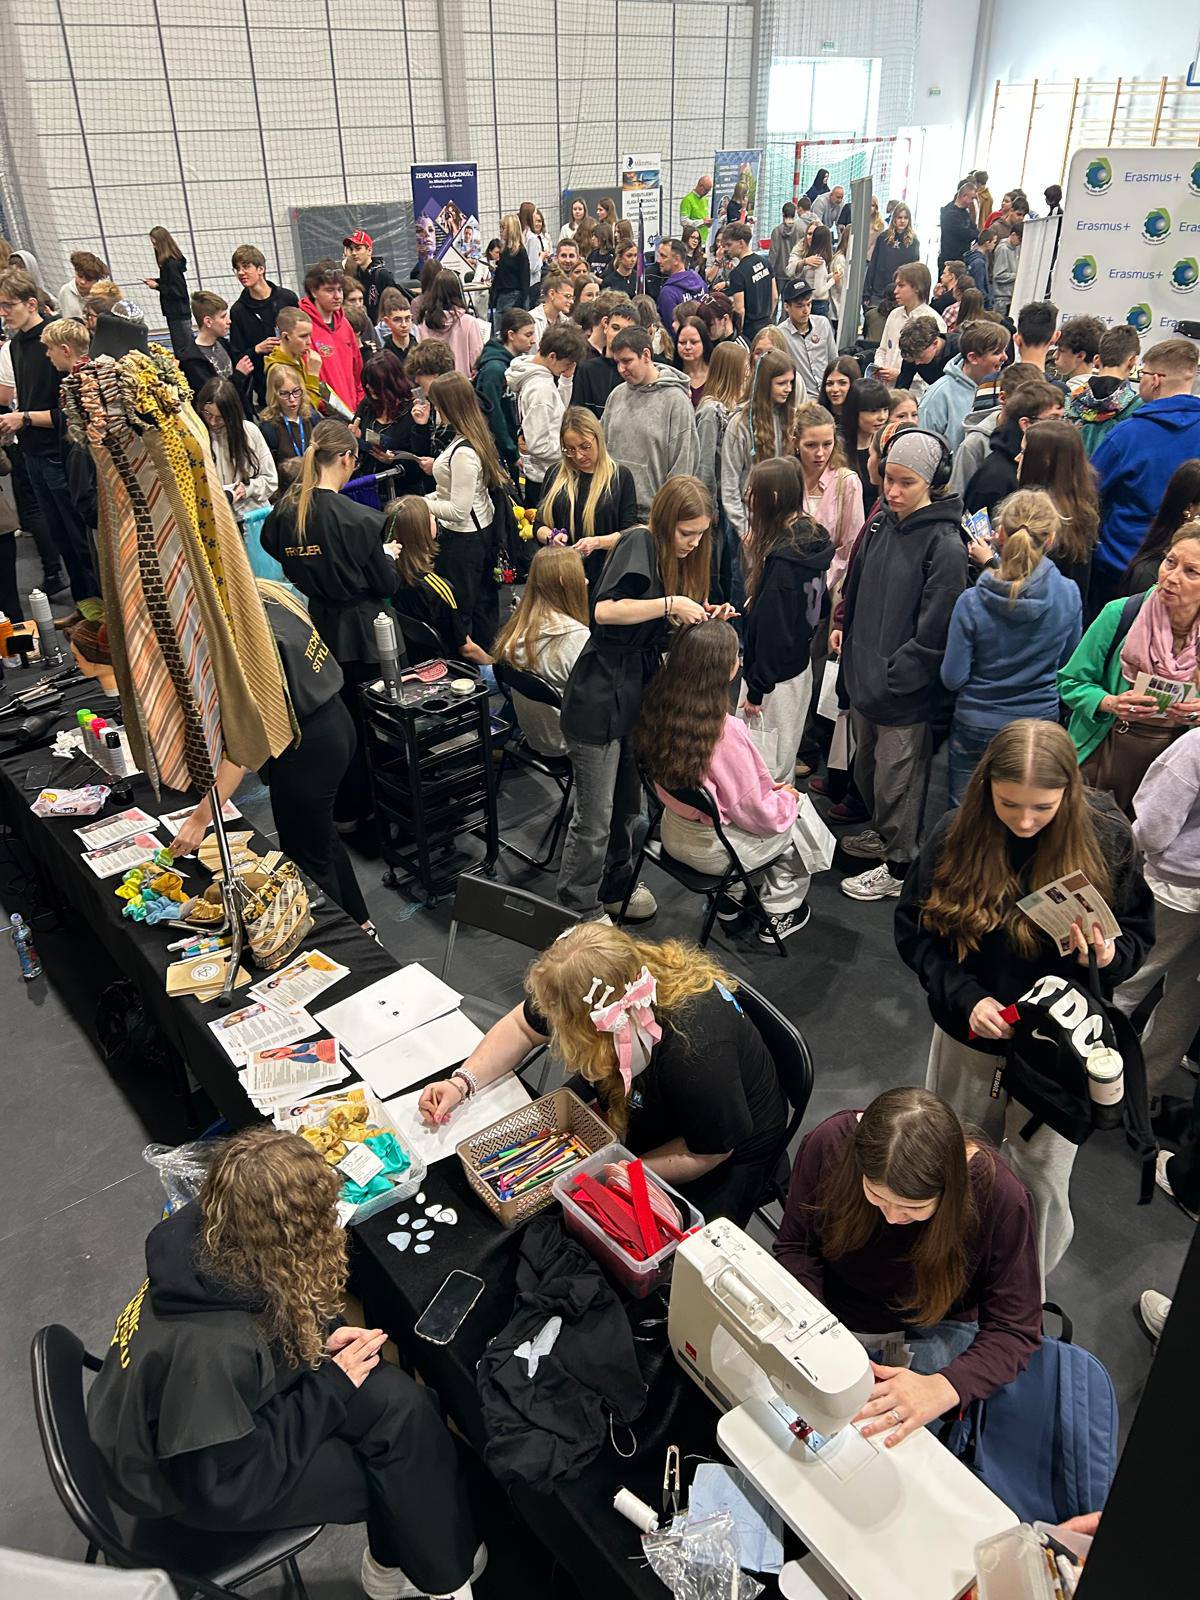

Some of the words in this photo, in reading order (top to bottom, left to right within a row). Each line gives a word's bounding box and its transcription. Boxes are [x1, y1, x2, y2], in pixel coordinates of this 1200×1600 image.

[1124, 172, 1182, 183] Erasmus+
[1076, 220, 1131, 231] Erasmus+
[1109, 269, 1164, 280] Erasmus+
